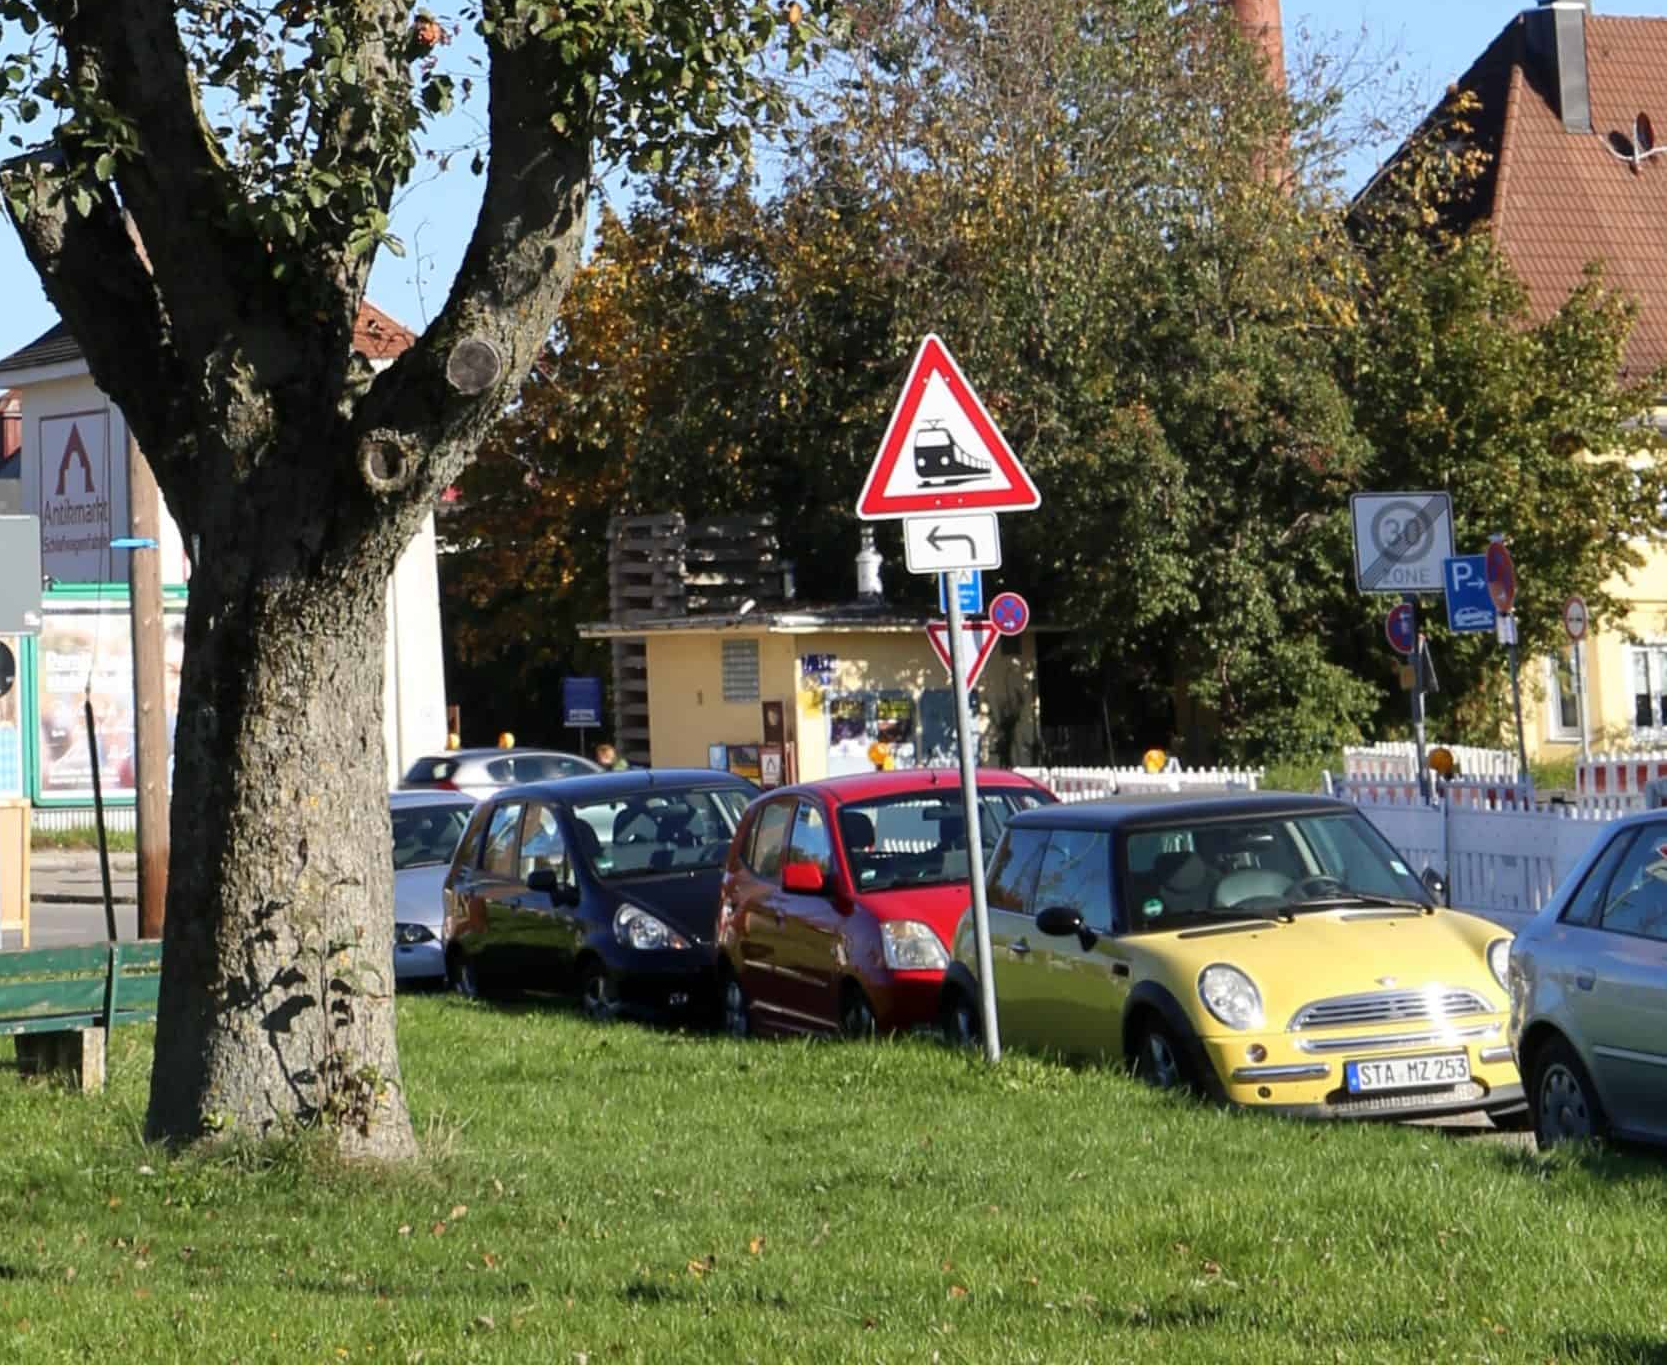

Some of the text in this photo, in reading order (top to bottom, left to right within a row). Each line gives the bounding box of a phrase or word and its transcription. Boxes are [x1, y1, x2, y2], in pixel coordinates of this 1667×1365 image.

[1384, 518, 1422, 546] 30
[1384, 568, 1430, 584] ZONE
[1451, 562, 1473, 592] P
[1360, 1057, 1467, 1085] STA MZ 253
